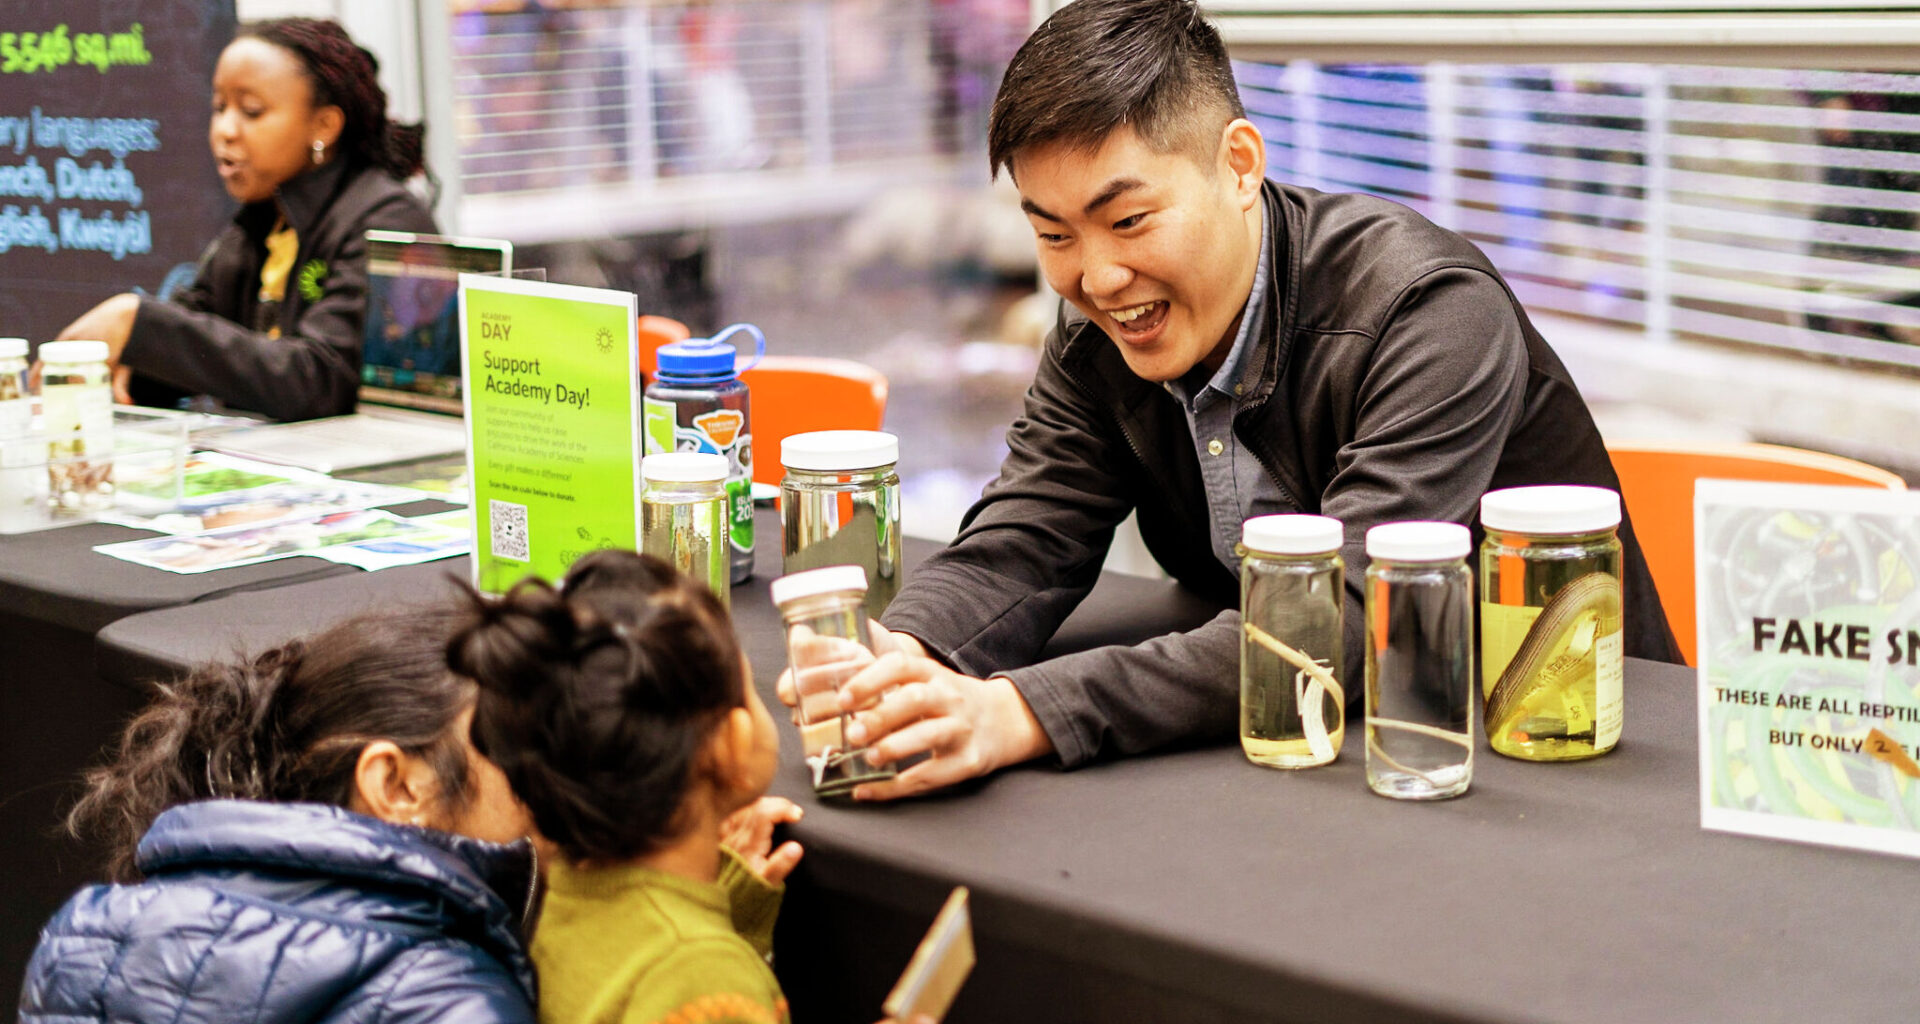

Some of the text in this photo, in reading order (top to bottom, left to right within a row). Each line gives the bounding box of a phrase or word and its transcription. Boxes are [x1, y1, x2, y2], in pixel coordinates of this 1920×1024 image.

[31, 106, 161, 157] languages:
[55, 157, 143, 207] Dutch,
[482, 312, 512, 321] ACADEMY
[482, 322, 512, 341] DAY
[484, 350, 541, 376] Support
[485, 374, 590, 410] Academy Day!
[1753, 617, 1870, 661] FAKE
[1715, 688, 1920, 723] THESE ARE ALL REPTIL
[1769, 730, 1805, 747] BUT
[1811, 734, 1863, 753] ONLY
[1874, 739, 1891, 753] 2
